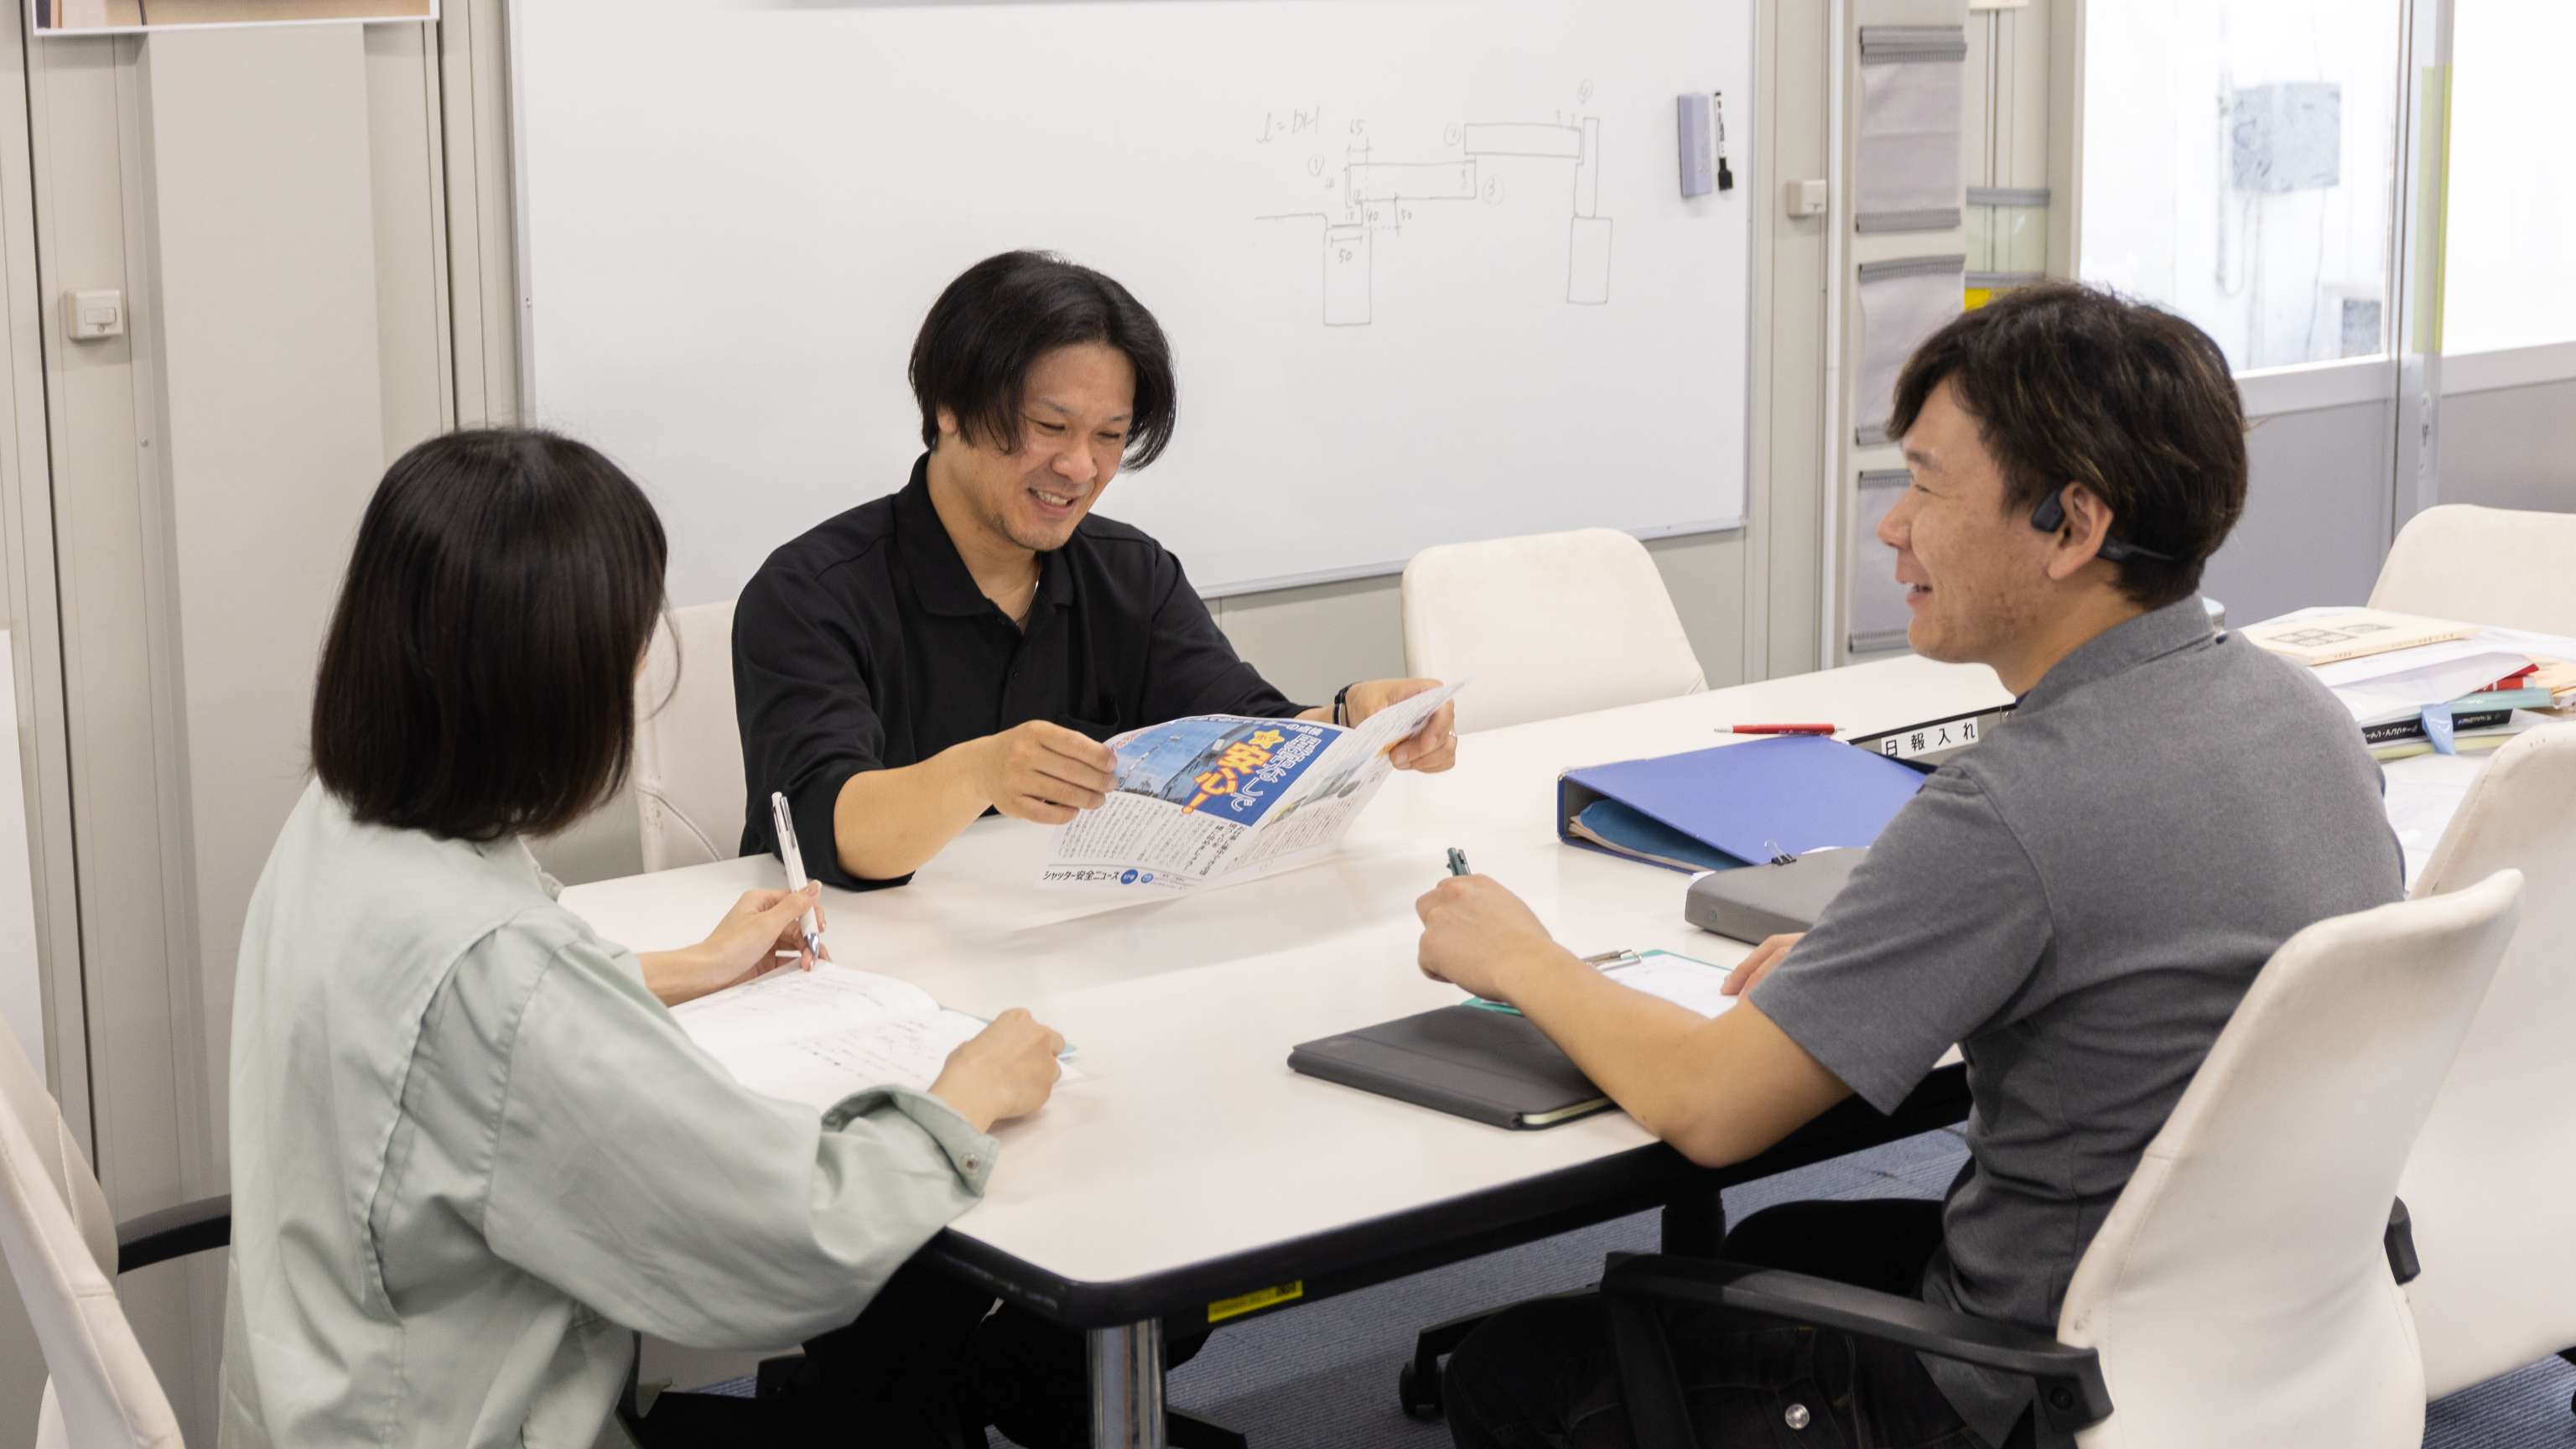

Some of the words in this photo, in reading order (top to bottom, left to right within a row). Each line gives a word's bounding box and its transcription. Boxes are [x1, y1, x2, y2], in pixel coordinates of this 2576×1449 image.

[1885, 721, 1976, 758] 日報入れ
[1043, 870, 1120, 881] シャッター安全ニュース
